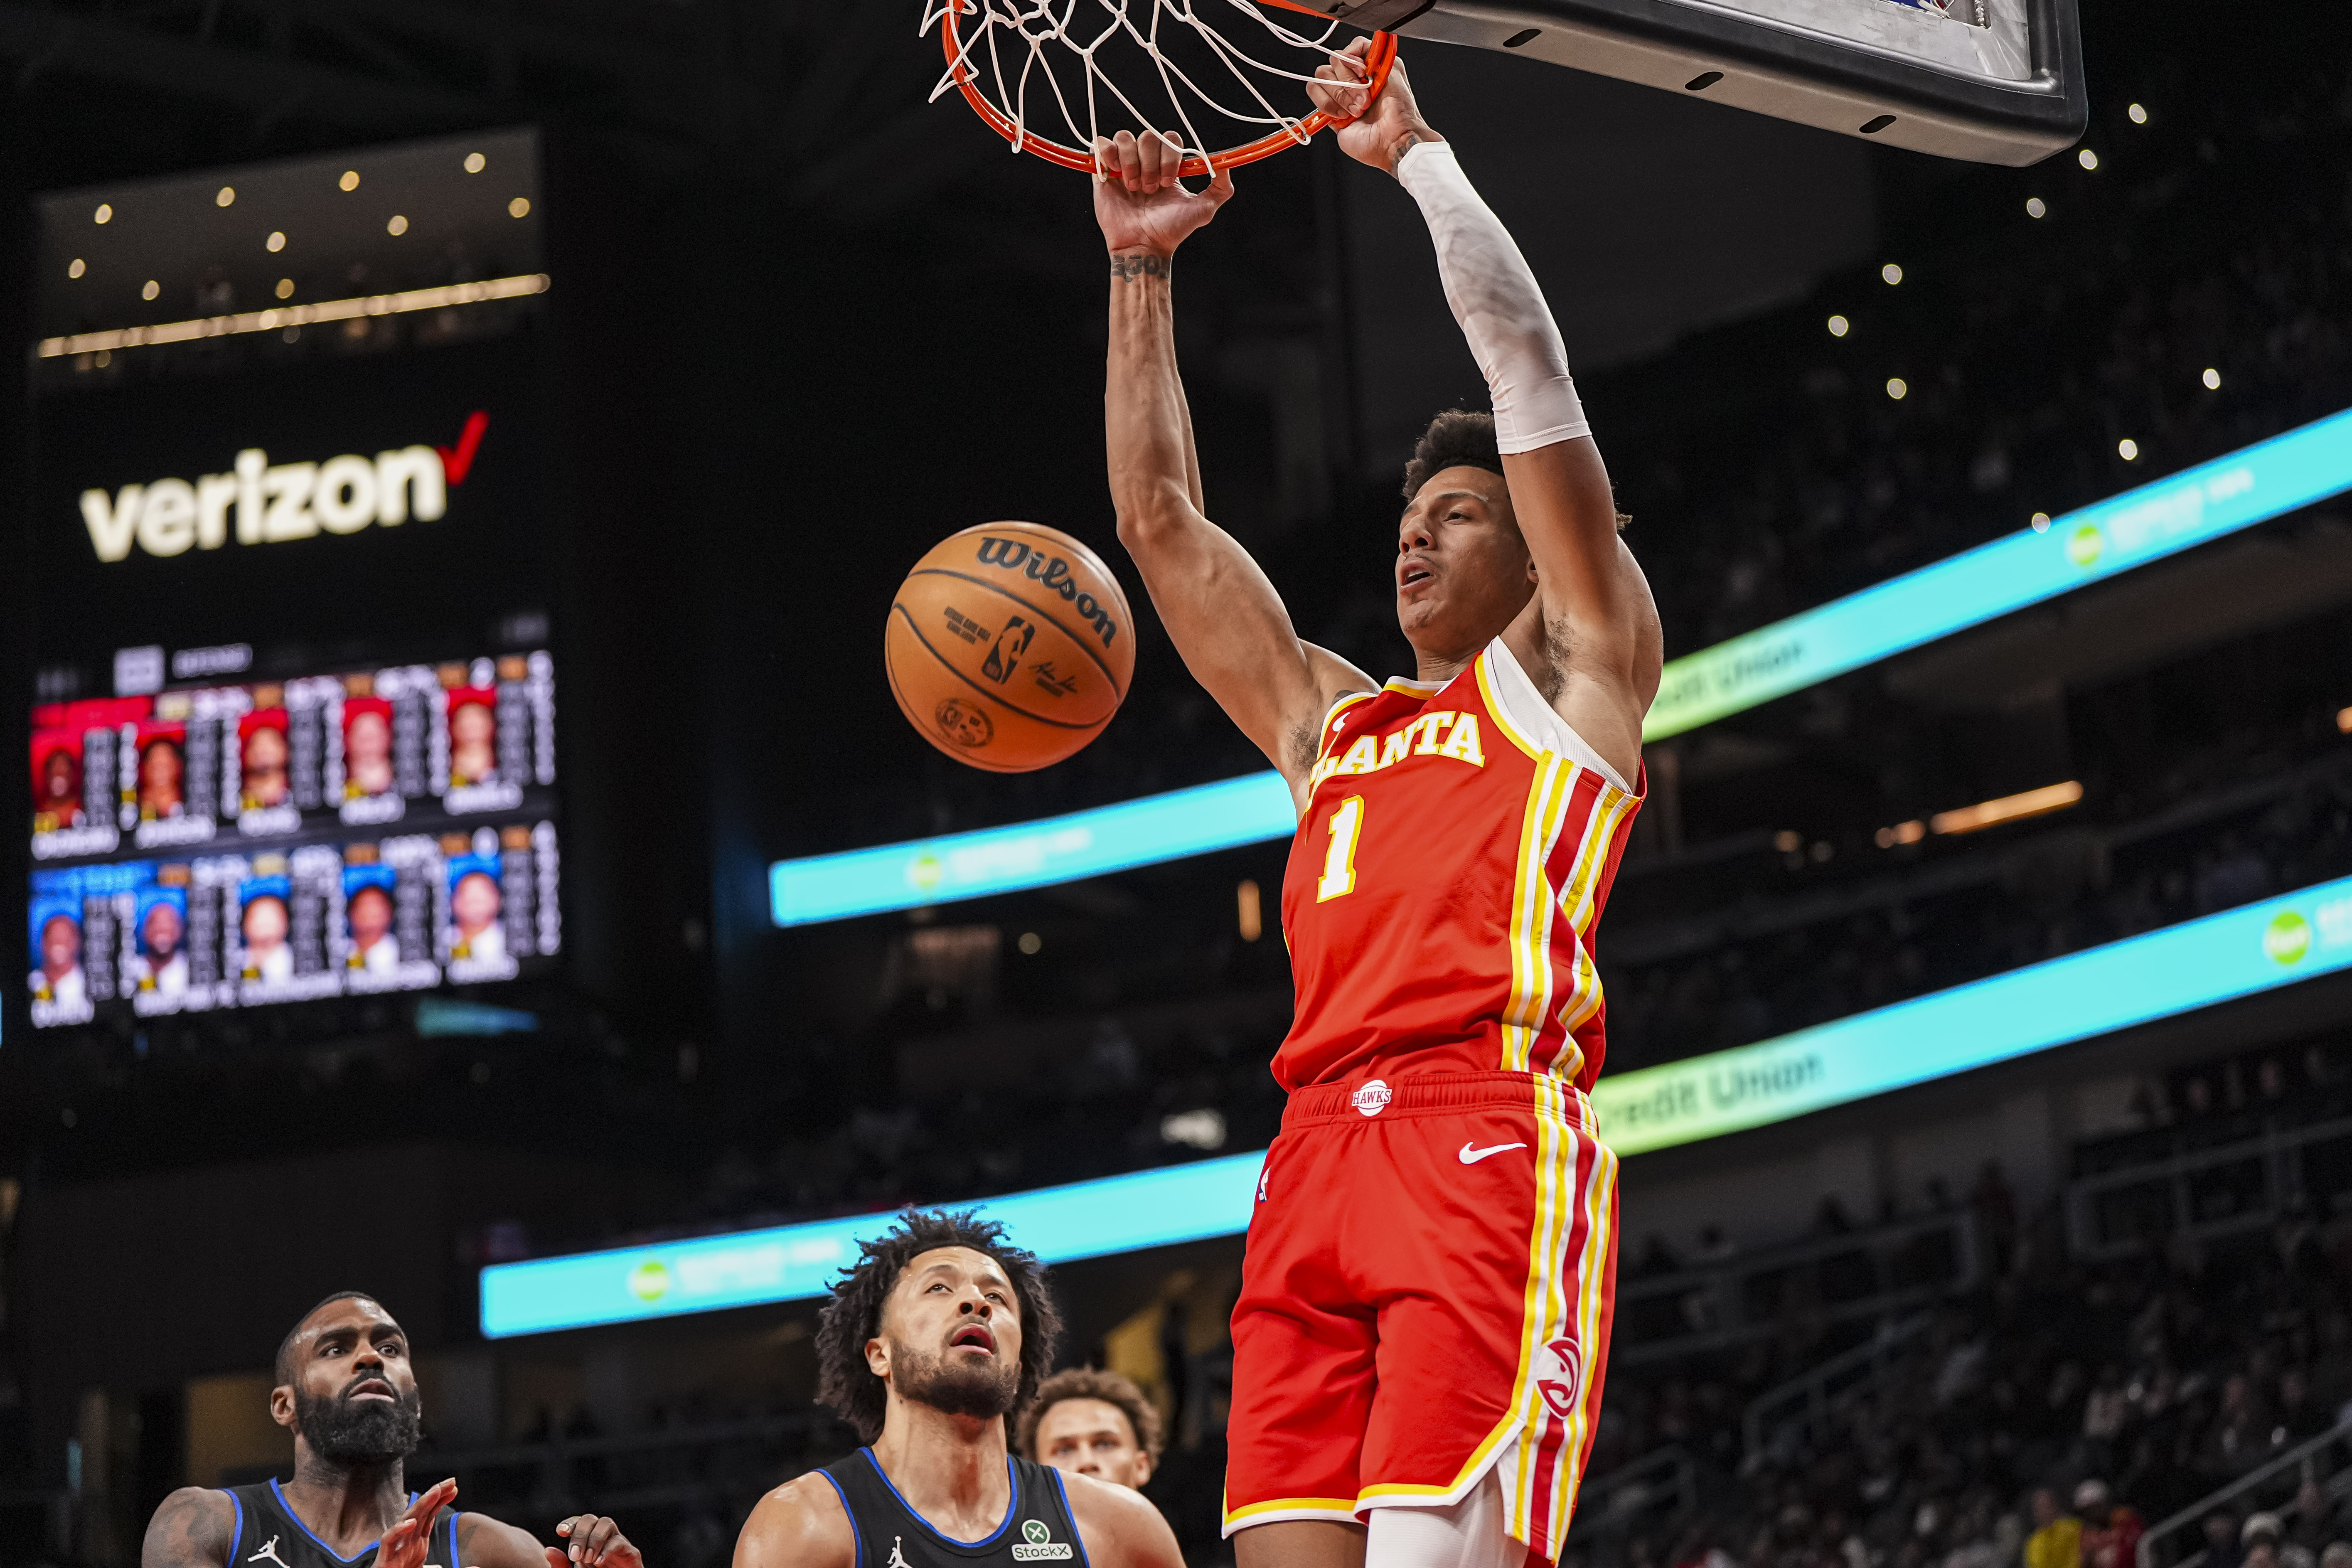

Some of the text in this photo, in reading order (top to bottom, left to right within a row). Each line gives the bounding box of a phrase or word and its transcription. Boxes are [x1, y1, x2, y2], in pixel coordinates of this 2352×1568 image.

[80, 444, 447, 564] verizon
[977, 537, 1116, 648] Wilson
[1316, 794, 1365, 904] 1
[1353, 1090, 1391, 1105] HAWKS
[1014, 1545, 1069, 1558] StockX
